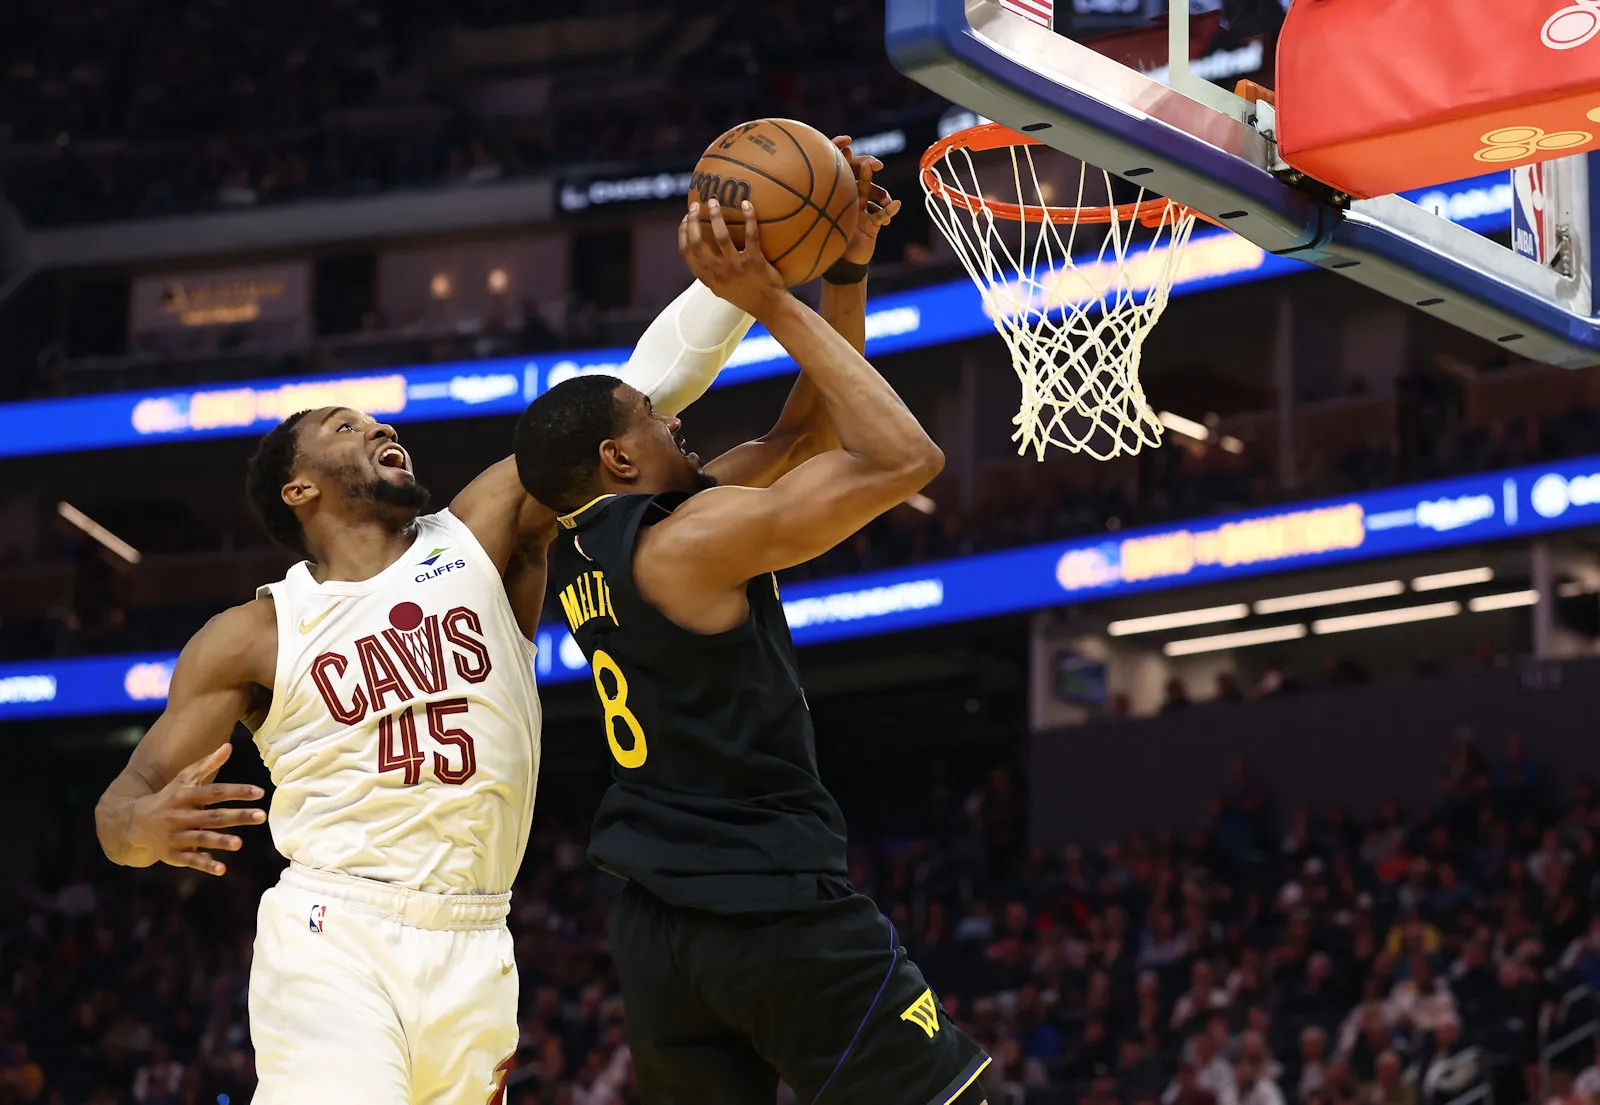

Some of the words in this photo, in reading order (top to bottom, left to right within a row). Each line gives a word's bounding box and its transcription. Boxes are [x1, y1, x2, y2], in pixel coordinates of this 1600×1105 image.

[1516, 227, 1534, 256] NBA
[415, 559, 466, 583] CLIFFS
[311, 605, 492, 726] CAVS
[592, 649, 648, 769] 8
[378, 697, 477, 785] 45
